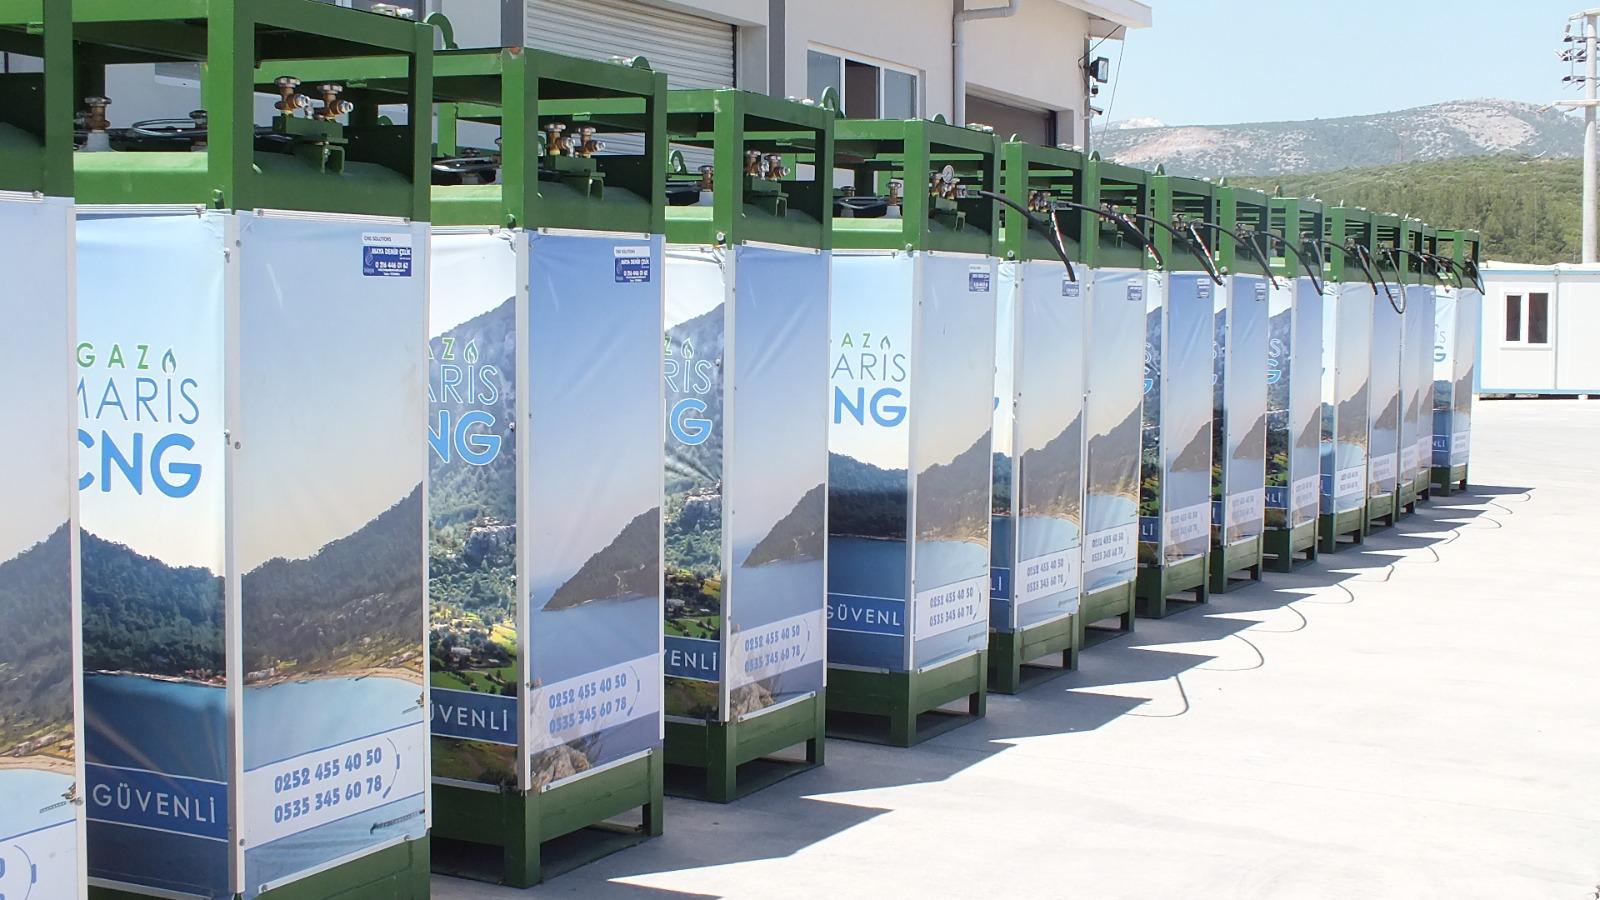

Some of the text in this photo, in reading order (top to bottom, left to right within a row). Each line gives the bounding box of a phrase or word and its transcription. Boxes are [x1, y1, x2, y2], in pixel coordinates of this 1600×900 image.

[76, 342, 149, 369] GAZ
[834, 385, 907, 427] NG
[766, 631, 779, 645] 455
[792, 624, 800, 637] 50
[664, 649, 717, 671] ENLİ
[549, 673, 627, 710] 0252 455 40 50
[549, 696, 627, 735] 0535 345 60 78
[274, 746, 382, 794] 0252 455 40 50
[92, 782, 216, 824] GÜVENLİ
[274, 774, 382, 823] 0535 345 60 78
